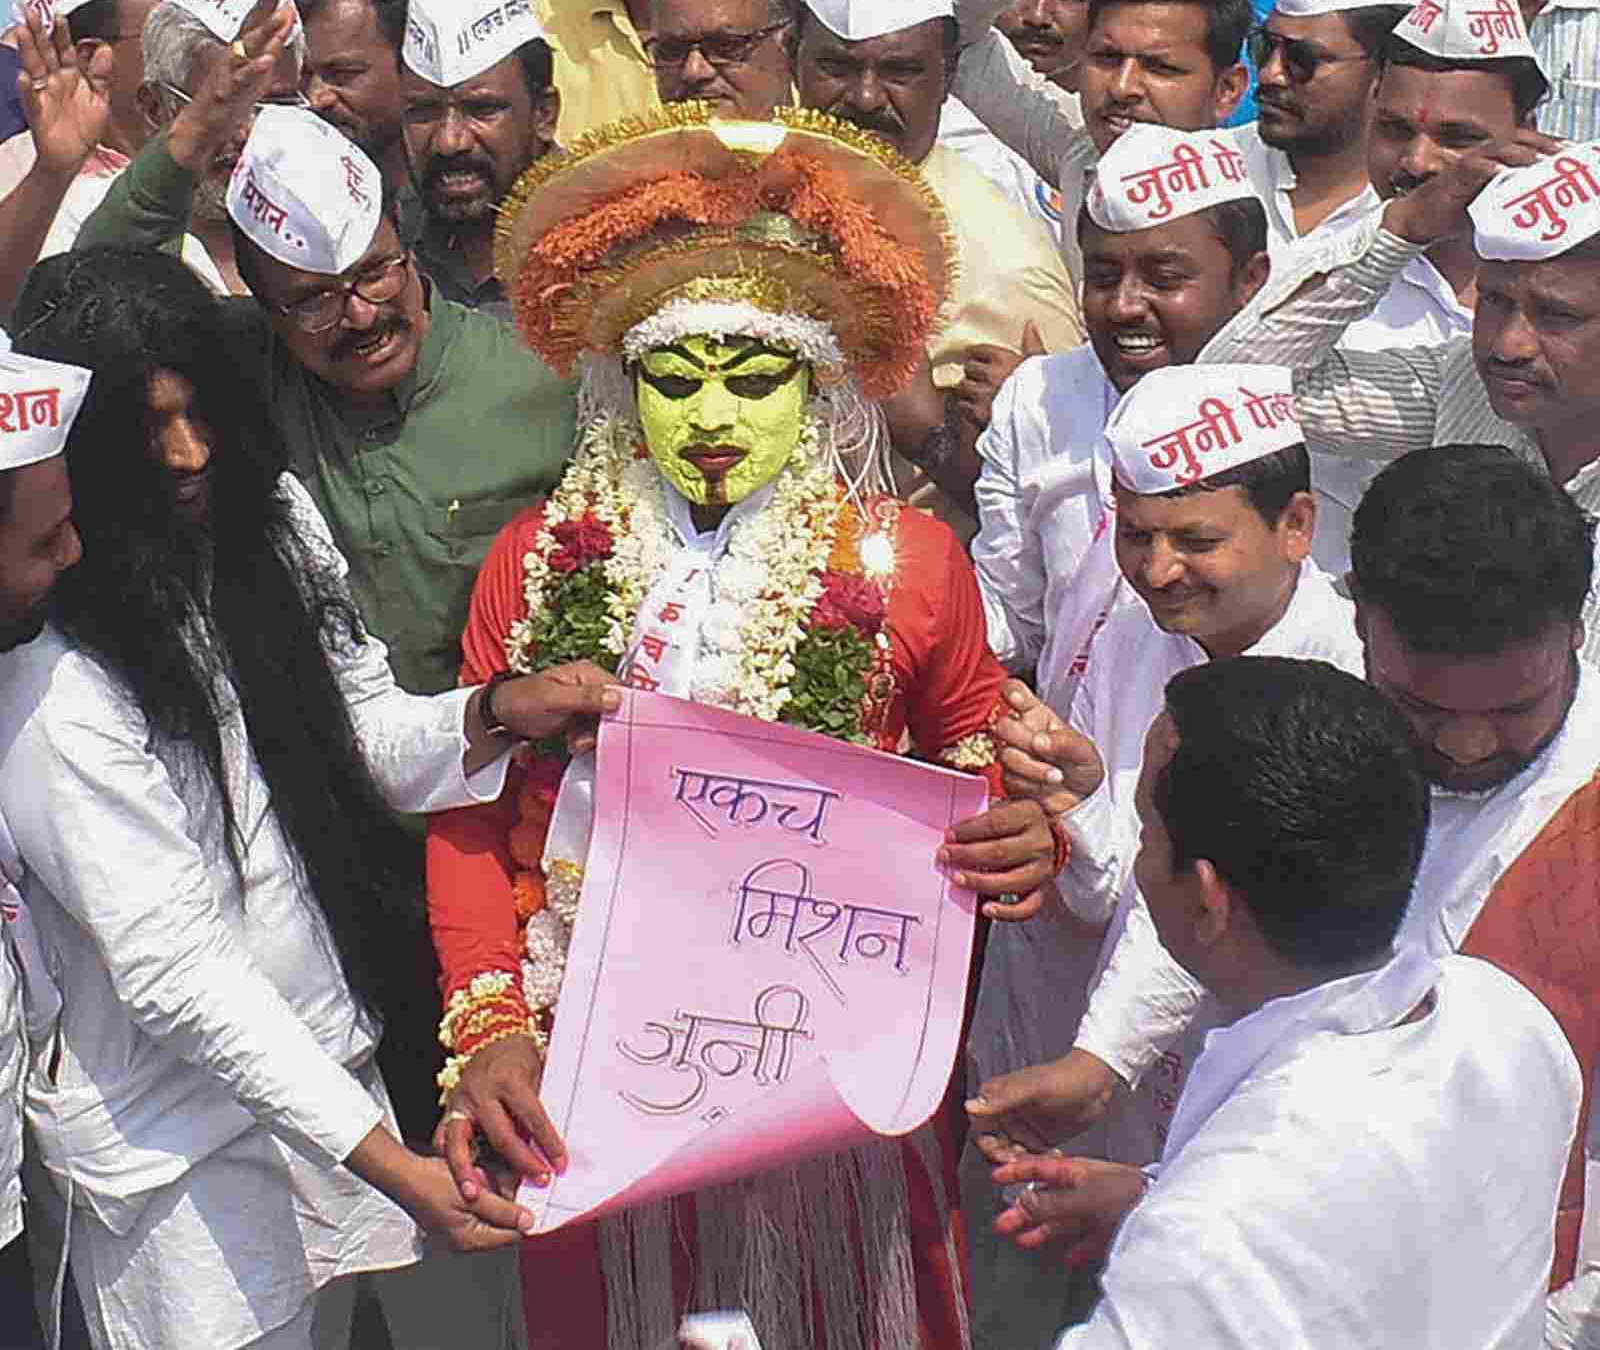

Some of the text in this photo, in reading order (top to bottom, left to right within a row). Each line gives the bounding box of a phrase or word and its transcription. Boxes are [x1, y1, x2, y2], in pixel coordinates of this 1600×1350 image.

[1118, 143, 1212, 220] जुनी
[1137, 398, 1245, 486] जुनी
[672, 766, 840, 841] एकच
[730, 858, 922, 1005] मिशन
[615, 983, 816, 1115] जुनी
